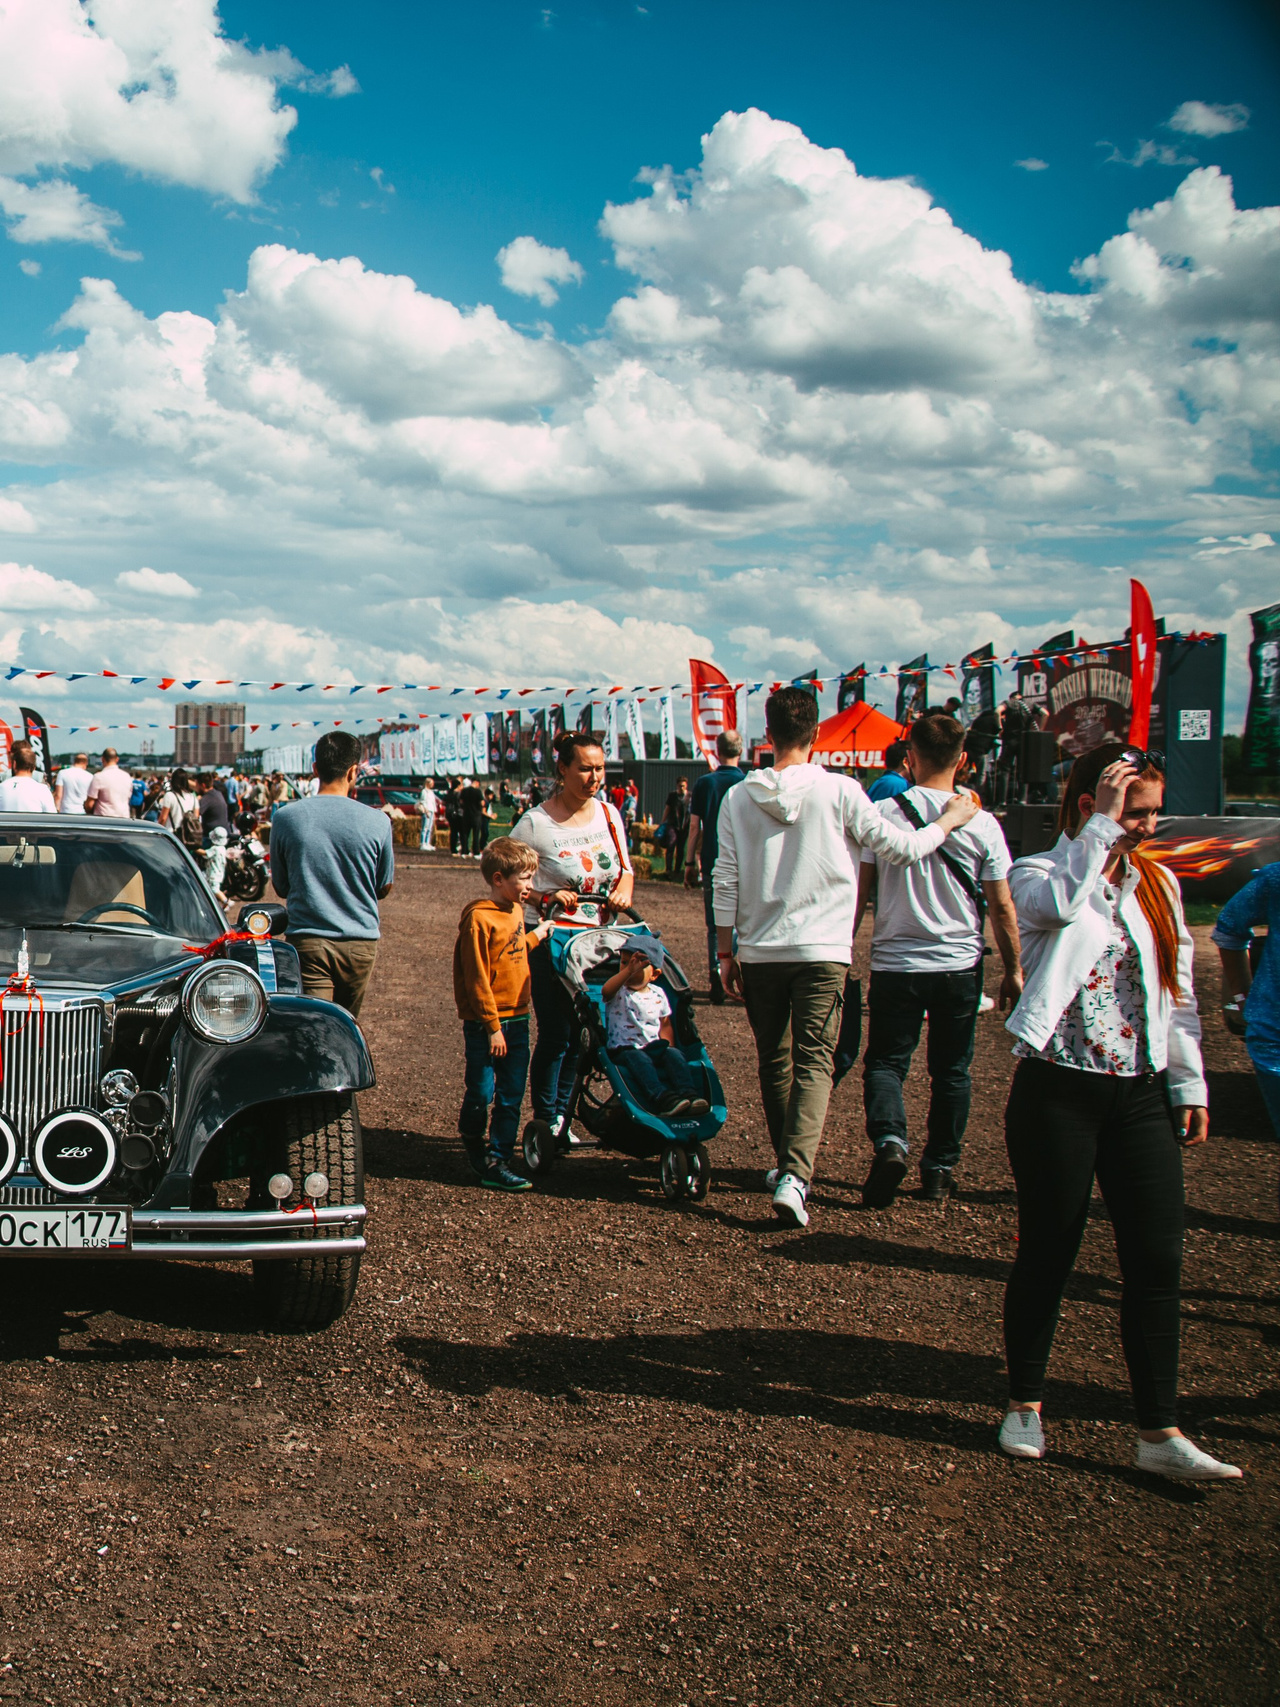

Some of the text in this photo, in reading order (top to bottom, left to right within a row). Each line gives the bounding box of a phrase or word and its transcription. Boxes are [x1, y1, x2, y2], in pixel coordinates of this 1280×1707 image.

[810, 750, 885, 767] MOTUL
[71, 1211, 122, 1237] 177
[82, 1238, 108, 1248] RUS
